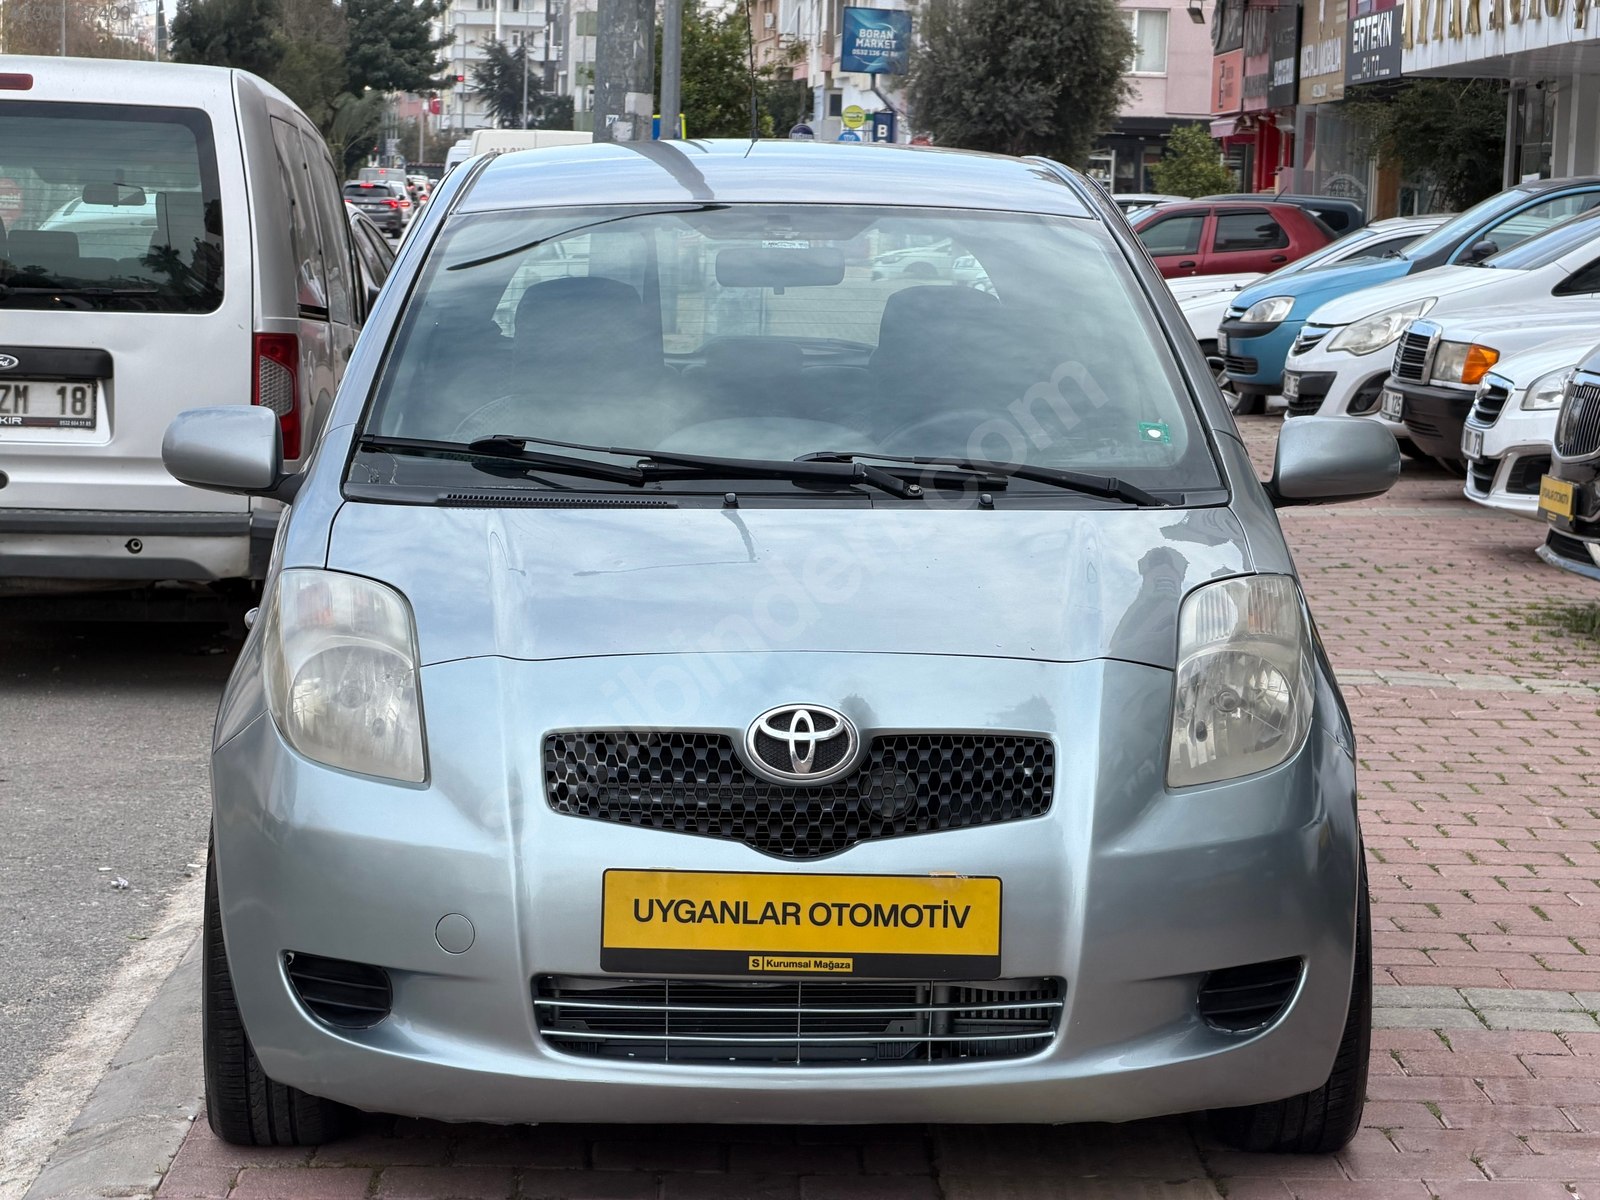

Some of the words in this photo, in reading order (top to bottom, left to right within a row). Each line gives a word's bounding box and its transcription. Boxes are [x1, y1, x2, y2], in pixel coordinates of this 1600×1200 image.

[859, 28, 894, 39] BORAN
[856, 38, 897, 49] MARKET
[57, 386, 87, 416] 18
[633, 898, 801, 926] UYGANLAR
[808, 899, 972, 929] OTOMOTİV
[766, 959, 811, 969] Kurumsal
[813, 960, 851, 971] Mağaza
